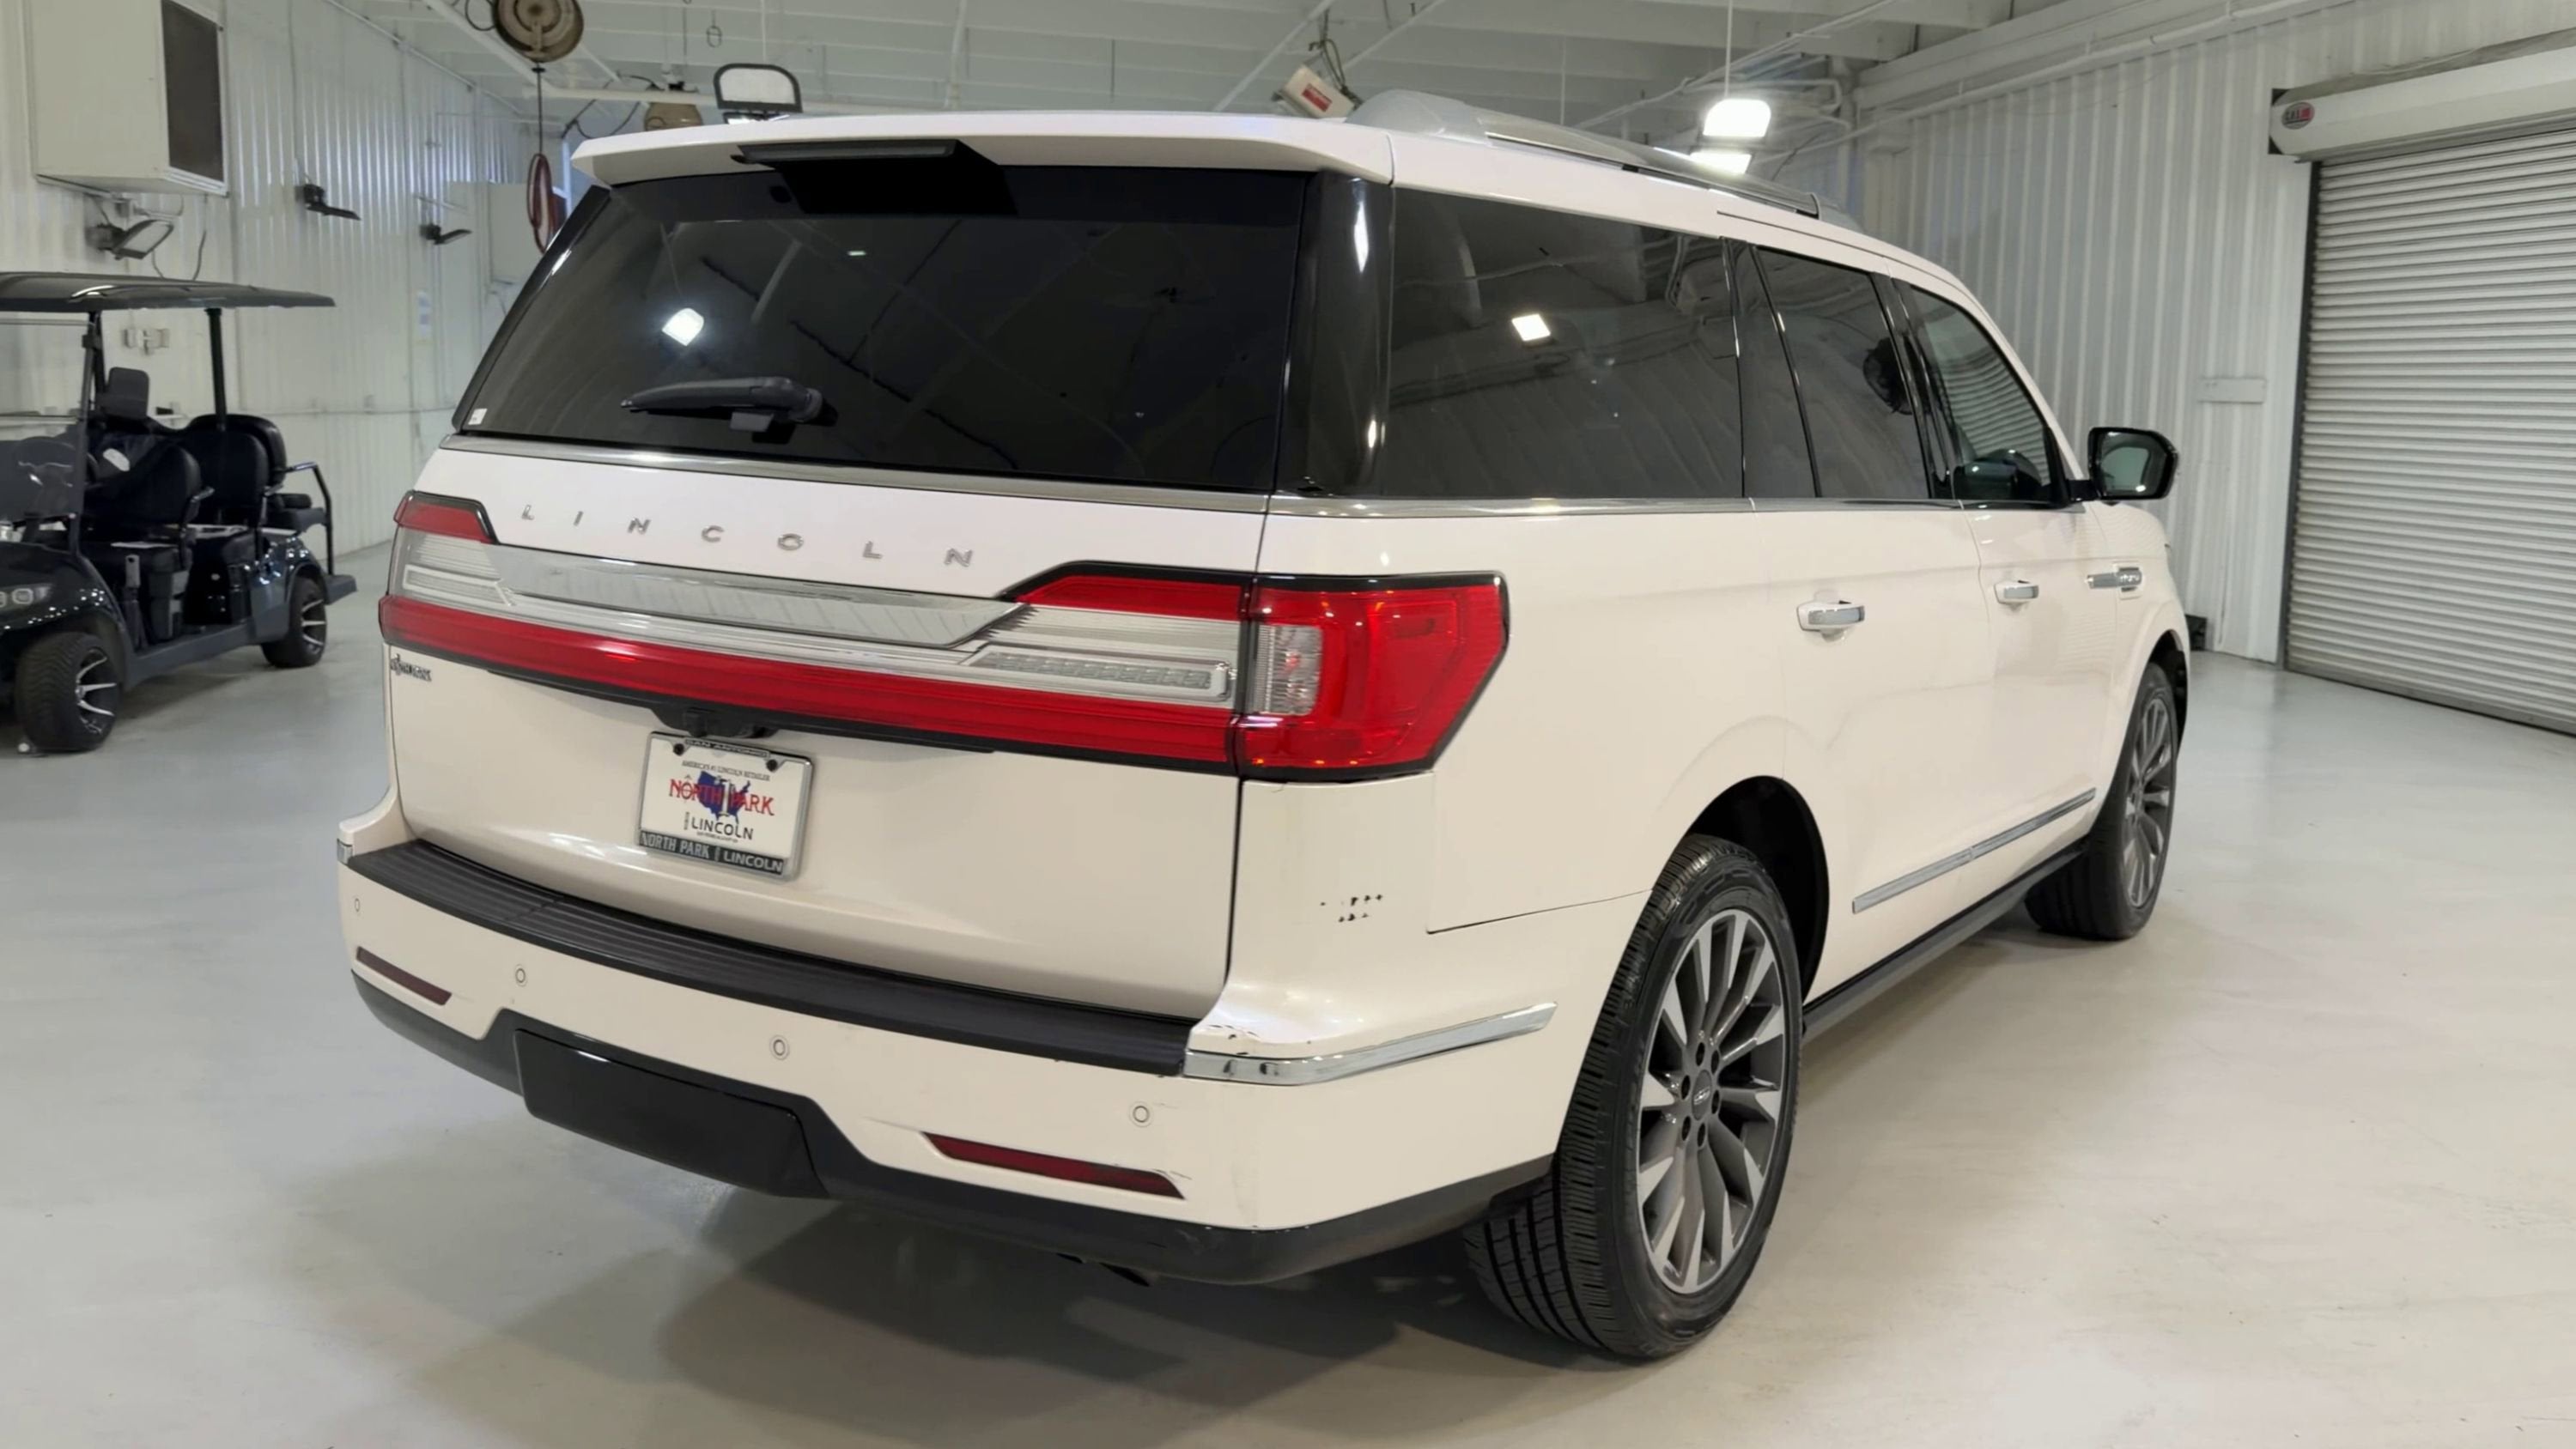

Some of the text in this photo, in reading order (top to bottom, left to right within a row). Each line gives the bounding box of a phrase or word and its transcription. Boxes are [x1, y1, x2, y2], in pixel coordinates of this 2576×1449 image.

[521, 504, 974, 567] LINCOLN
[669, 779, 722, 804] NORTH
[730, 790, 775, 816] PARK
[691, 816, 753, 840] LINCOLN
[641, 832, 677, 851] NORTH
[679, 840, 709, 859] PARK
[724, 851, 784, 872] LINCOLN
